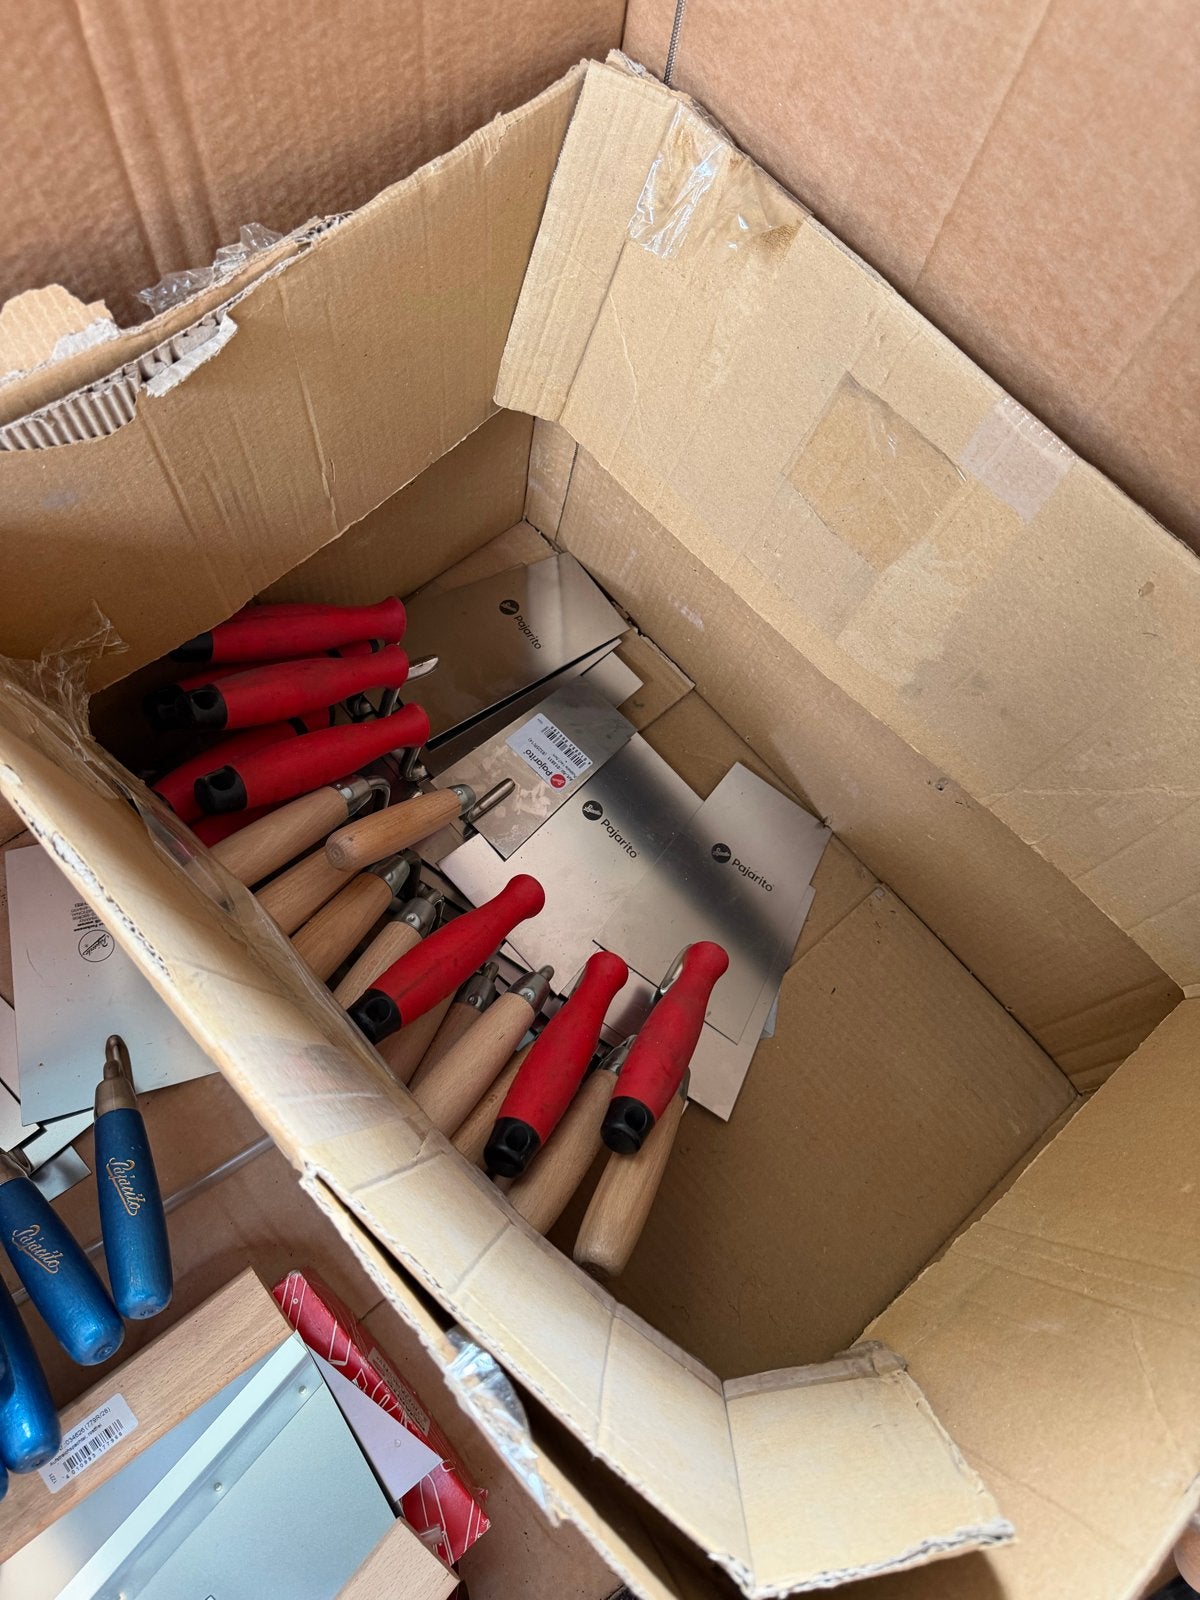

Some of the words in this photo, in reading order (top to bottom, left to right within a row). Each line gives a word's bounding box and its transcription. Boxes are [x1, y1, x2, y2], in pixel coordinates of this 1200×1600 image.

[513, 614, 543, 650] Pajarito
[524, 748, 553, 777] Pajarito
[600, 817, 638, 859] Pajarito
[731, 857, 772, 892] Pajarito
[106, 1157, 146, 1216] Pajarito
[11, 1224, 64, 1274] Pajarito
